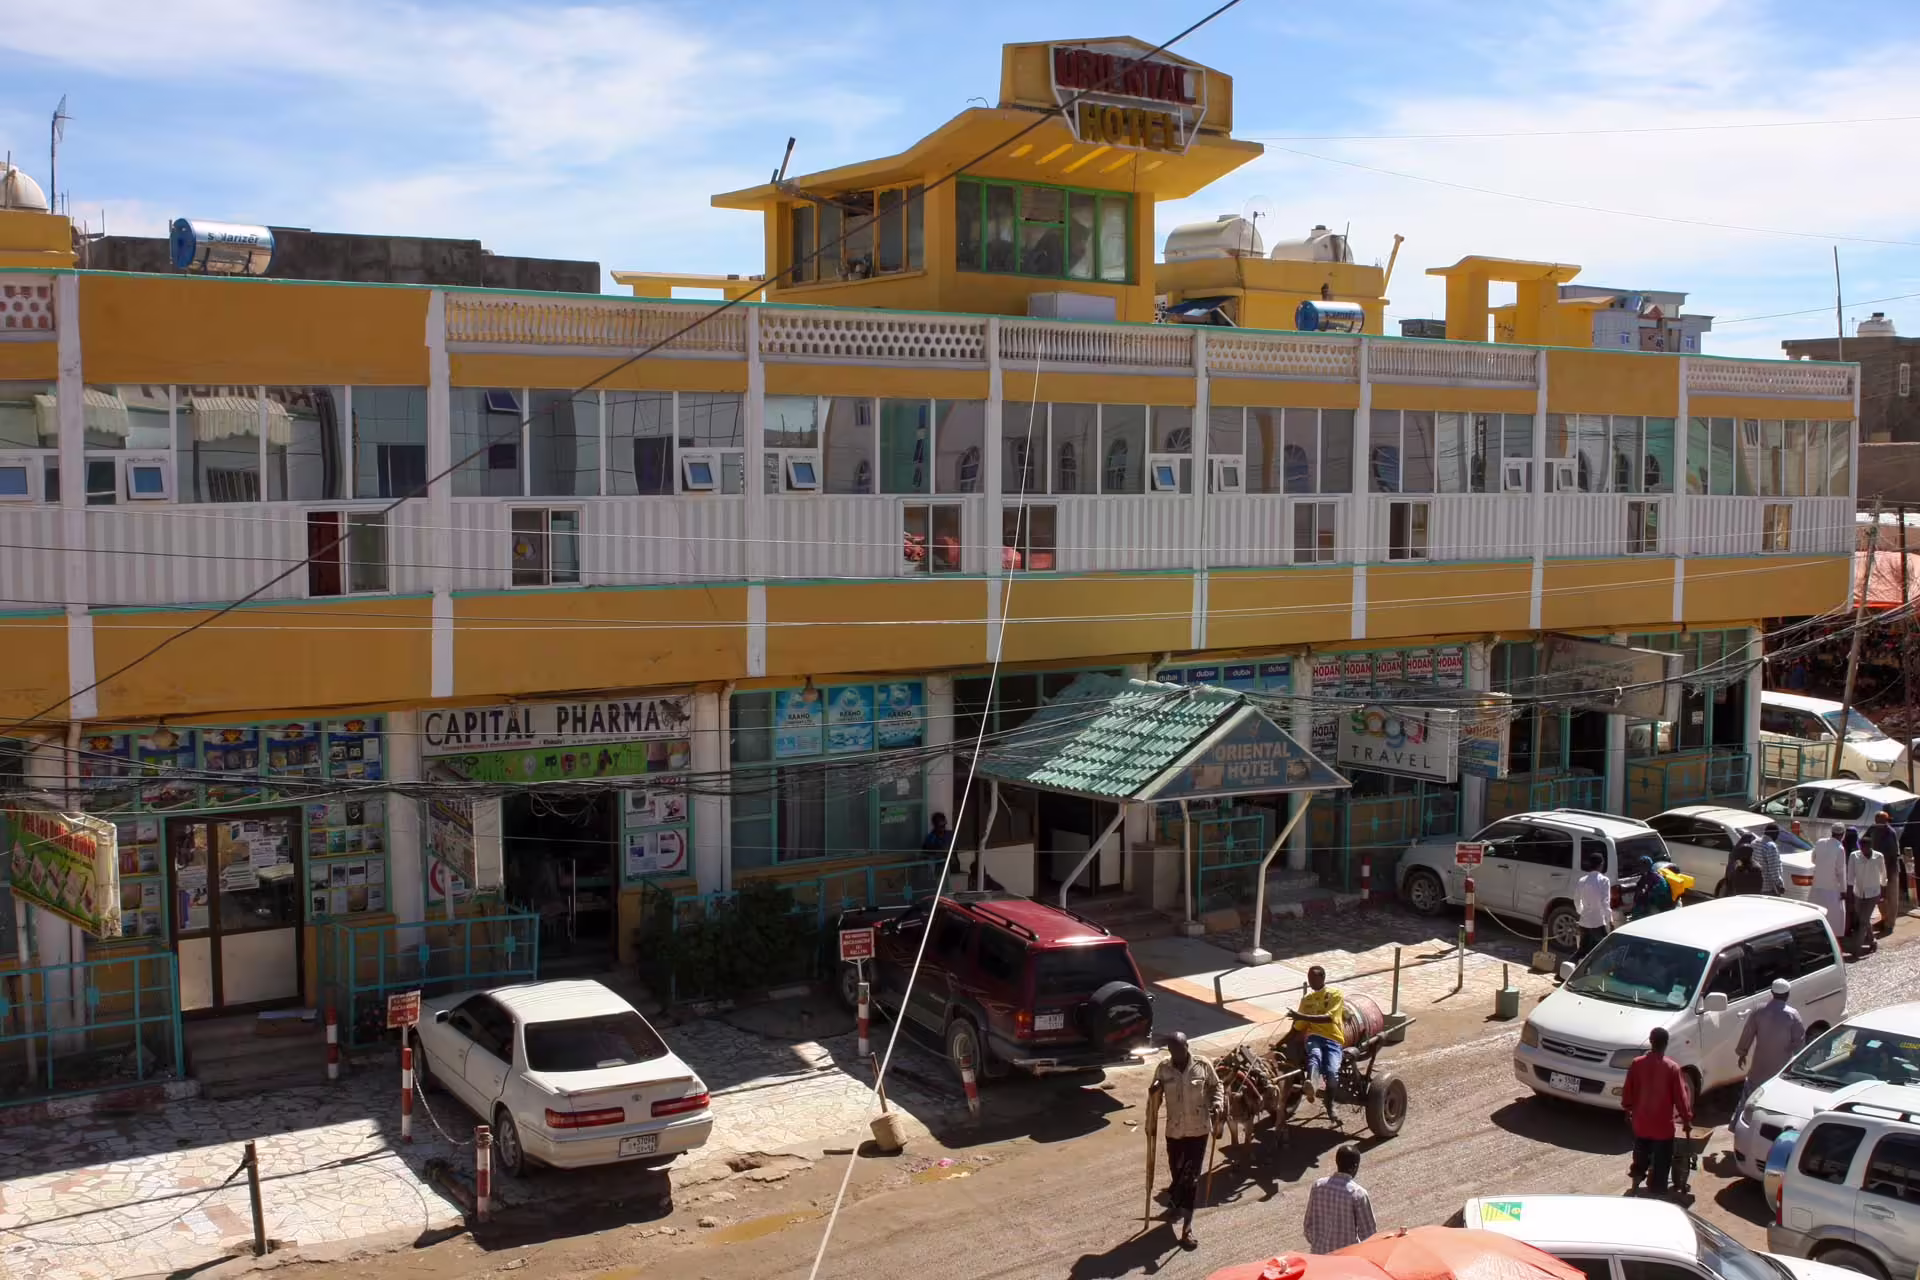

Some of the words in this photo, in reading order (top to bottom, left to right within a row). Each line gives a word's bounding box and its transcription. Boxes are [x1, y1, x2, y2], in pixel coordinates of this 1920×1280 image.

[1080, 103, 1185, 151] HOTEL
[1344, 663, 1372, 674] HODAN
[1375, 660, 1402, 672] HODAN
[1407, 658, 1433, 670] HODAN
[1437, 656, 1464, 668] HODAN
[1313, 664, 1341, 677] HODAN
[424, 709, 536, 745] CAPITAL
[556, 699, 661, 736] PHARMA
[1215, 741, 1292, 761] ORIENTAL
[1351, 745, 1432, 769] TRAVEL
[1227, 759, 1280, 779] HOTEL
